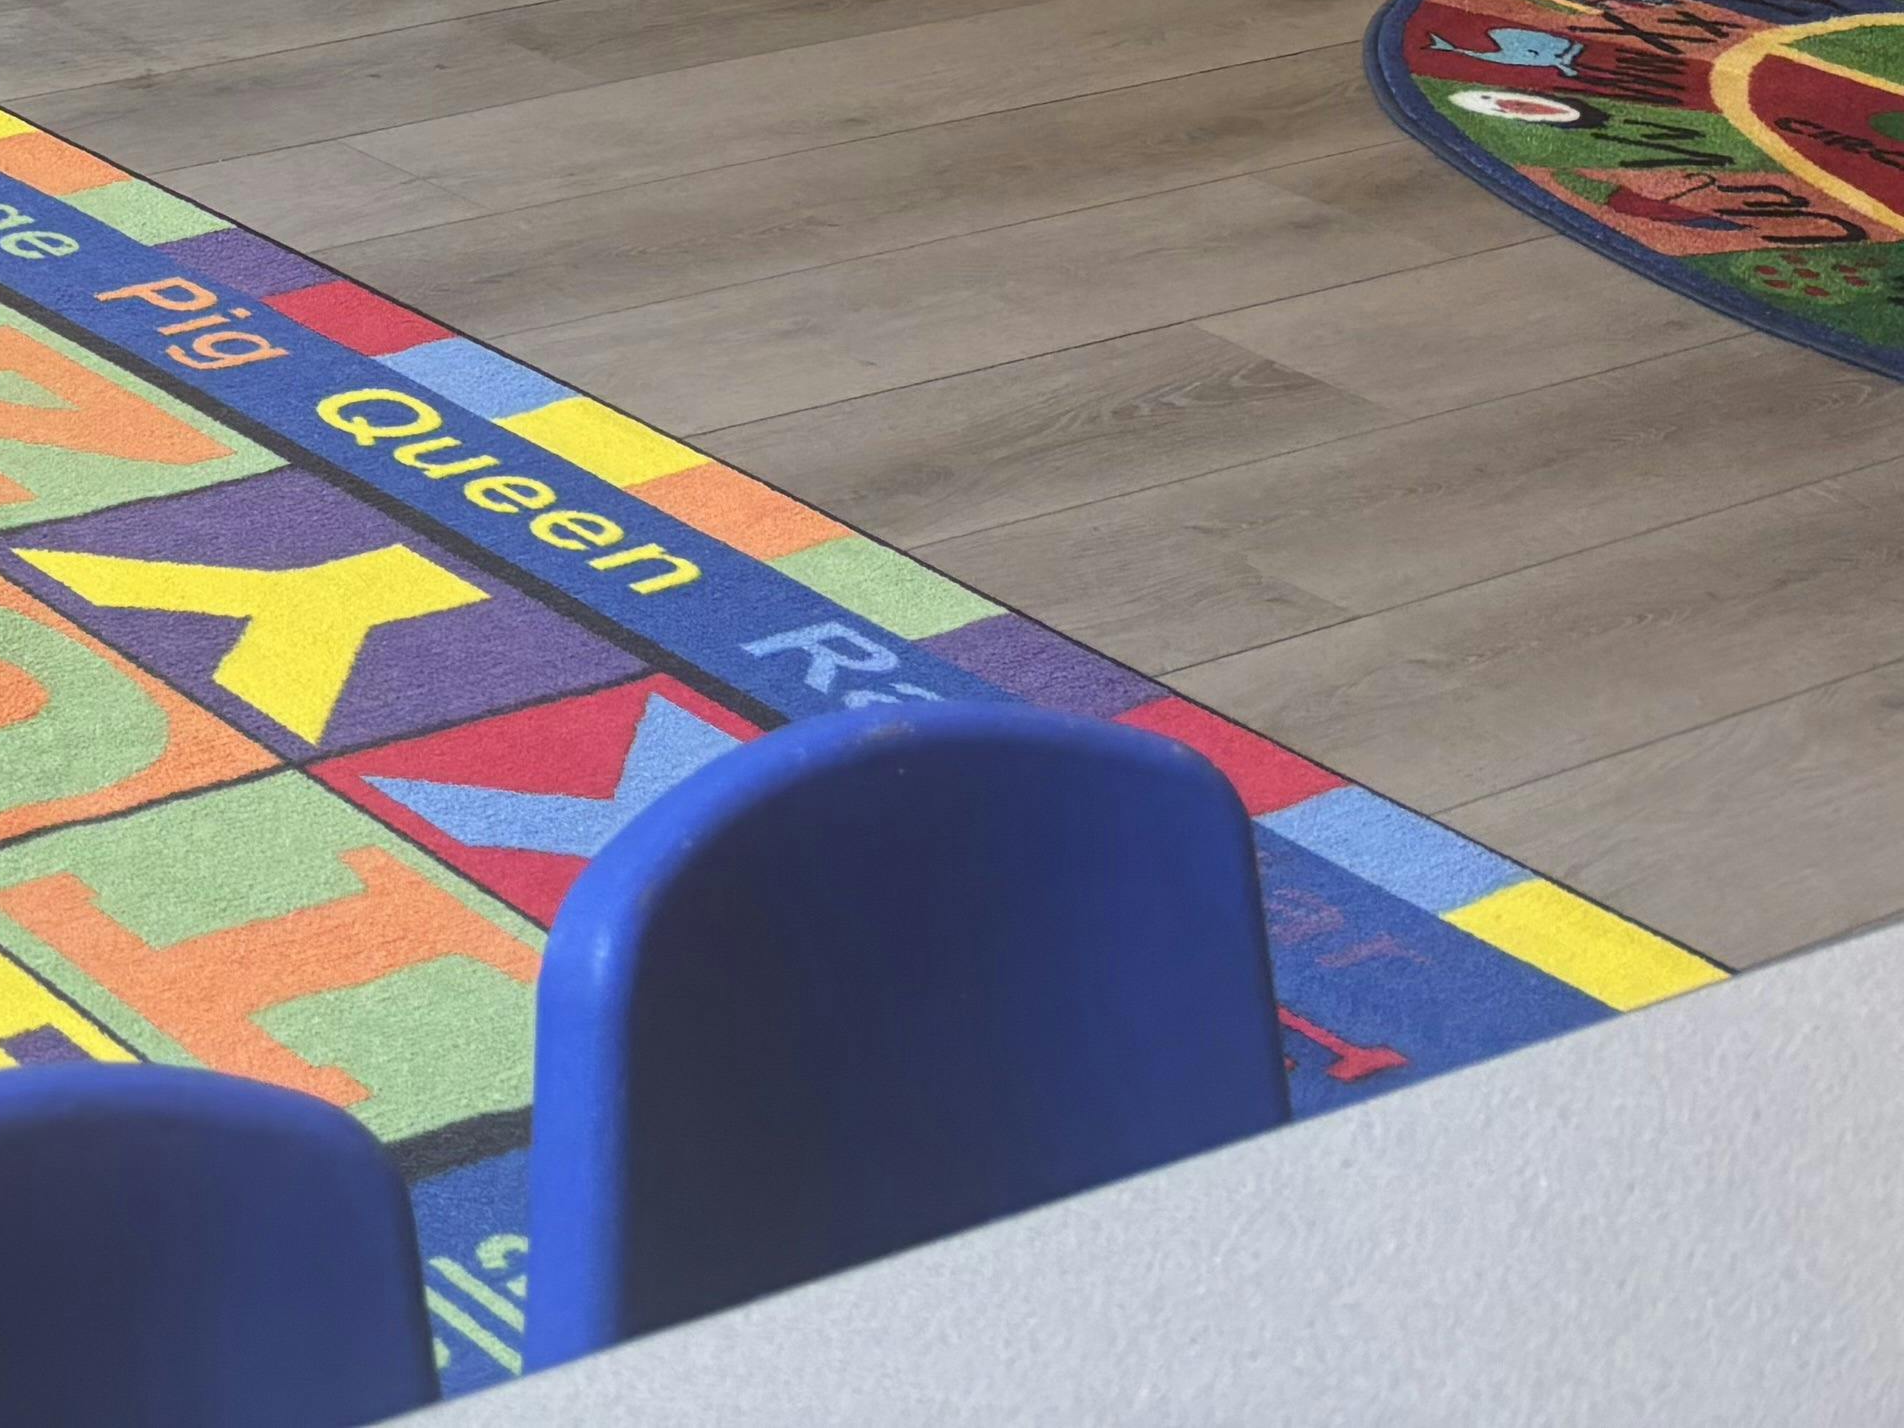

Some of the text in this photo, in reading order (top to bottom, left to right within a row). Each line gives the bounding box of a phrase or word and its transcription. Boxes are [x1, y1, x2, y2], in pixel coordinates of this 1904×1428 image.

[93, 276, 293, 371] Pig
[314, 386, 701, 595] Queen
[11, 543, 491, 745] Y
